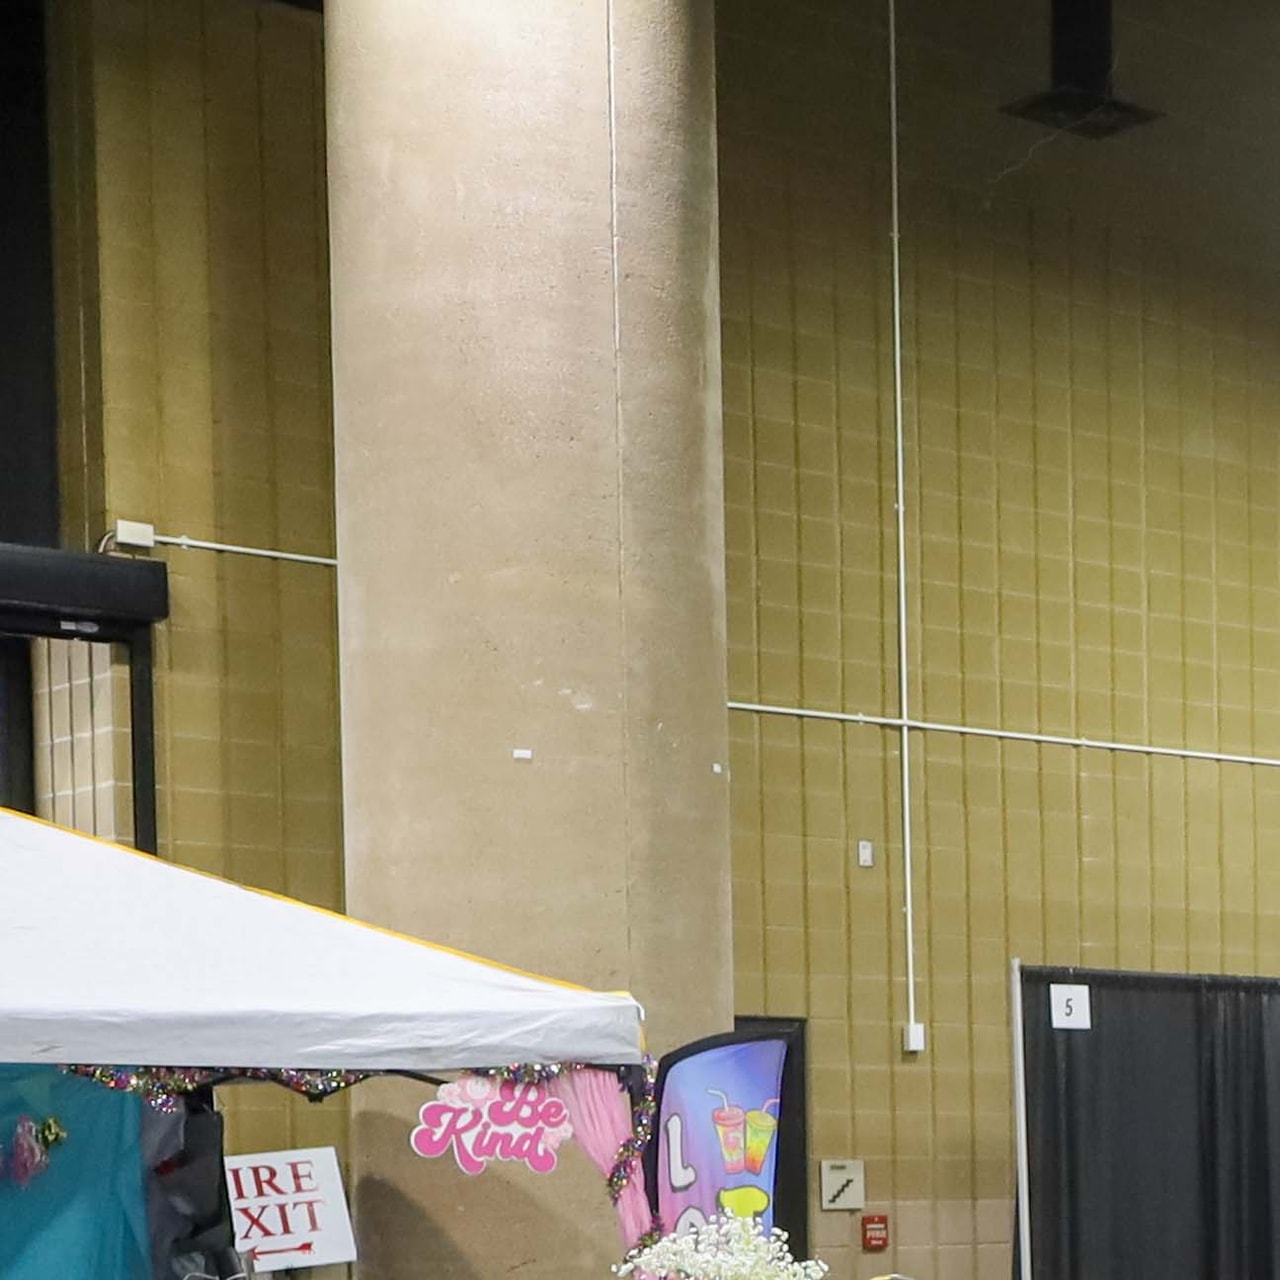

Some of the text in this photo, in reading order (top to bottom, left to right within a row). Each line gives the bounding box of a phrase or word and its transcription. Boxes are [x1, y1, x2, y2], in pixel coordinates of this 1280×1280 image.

[1064, 997, 1073, 1018] 5
[488, 1081, 568, 1127] Be
[413, 1103, 556, 1175] Kind
[228, 1160, 320, 1201] IRE
[235, 1200, 326, 1241] XIT
